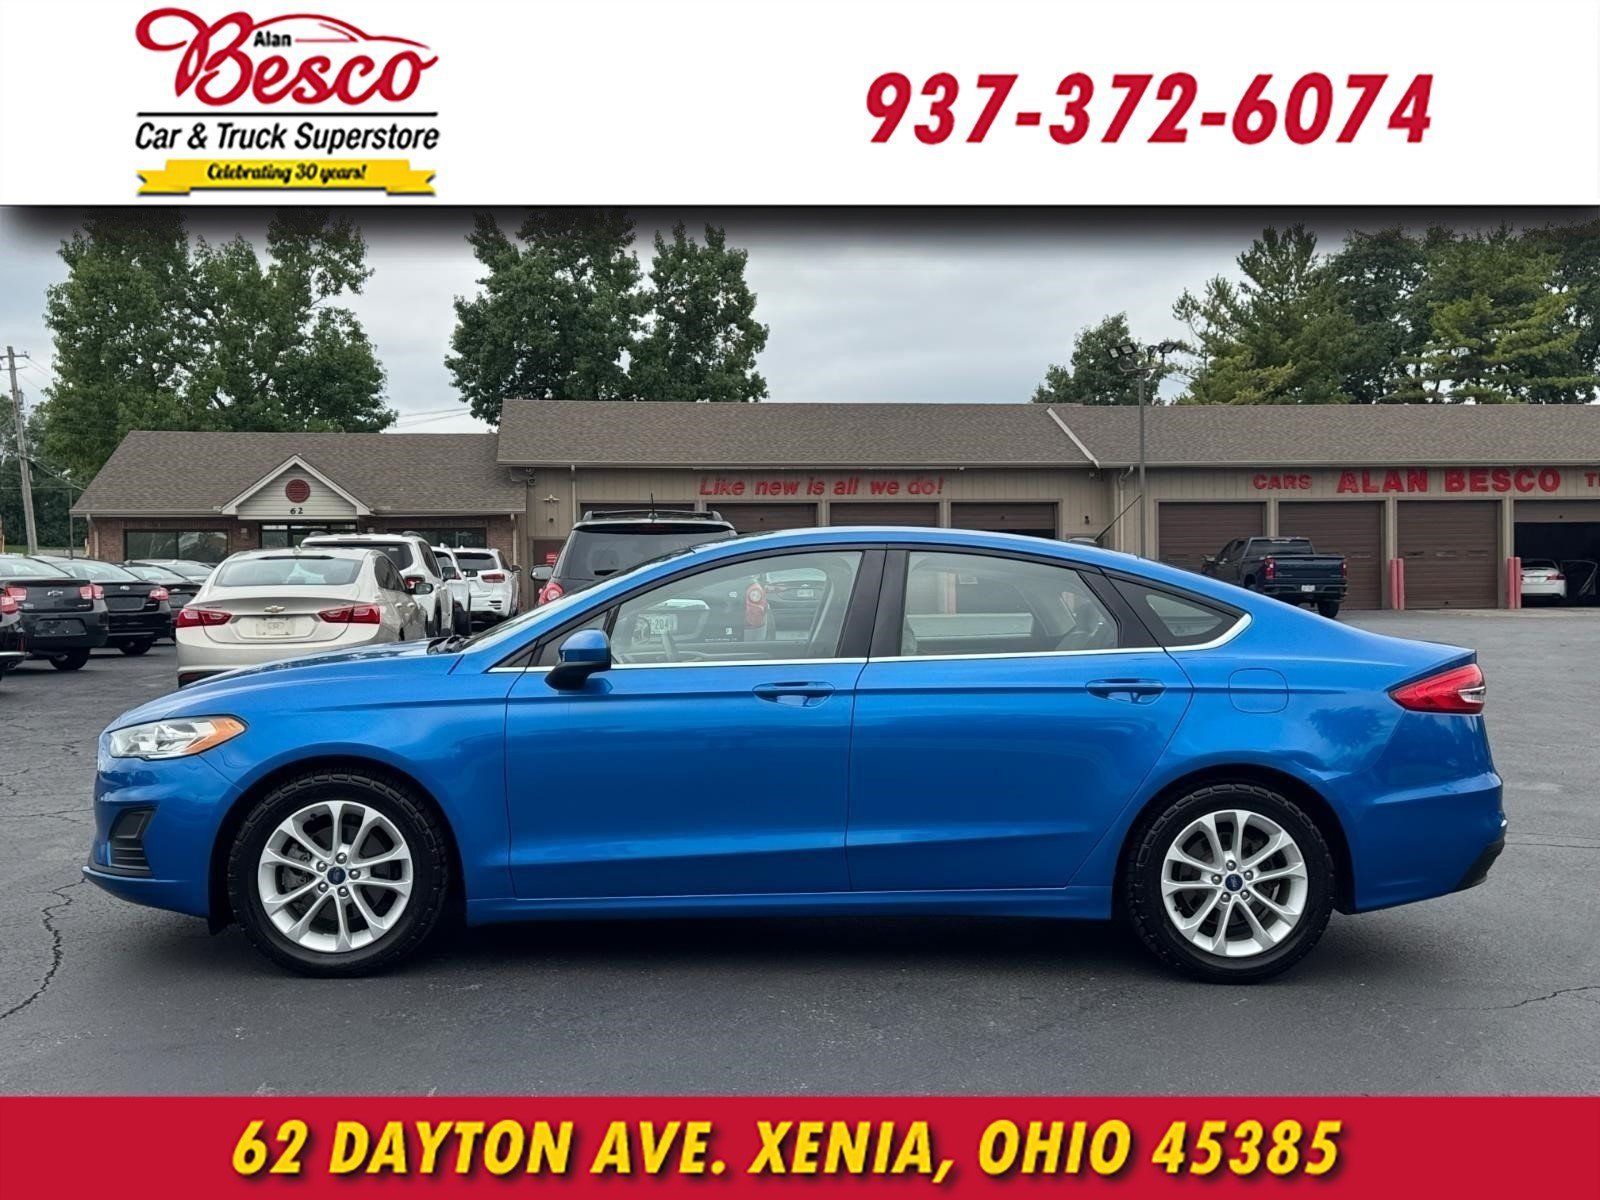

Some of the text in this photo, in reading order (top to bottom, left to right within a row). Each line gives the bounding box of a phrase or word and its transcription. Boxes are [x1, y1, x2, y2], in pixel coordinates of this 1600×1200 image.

[700, 476, 945, 495] Like new is all we do!
[1253, 474, 1313, 490] CARS
[1337, 468, 1429, 494] ALAN
[1444, 468, 1562, 493] BESCO
